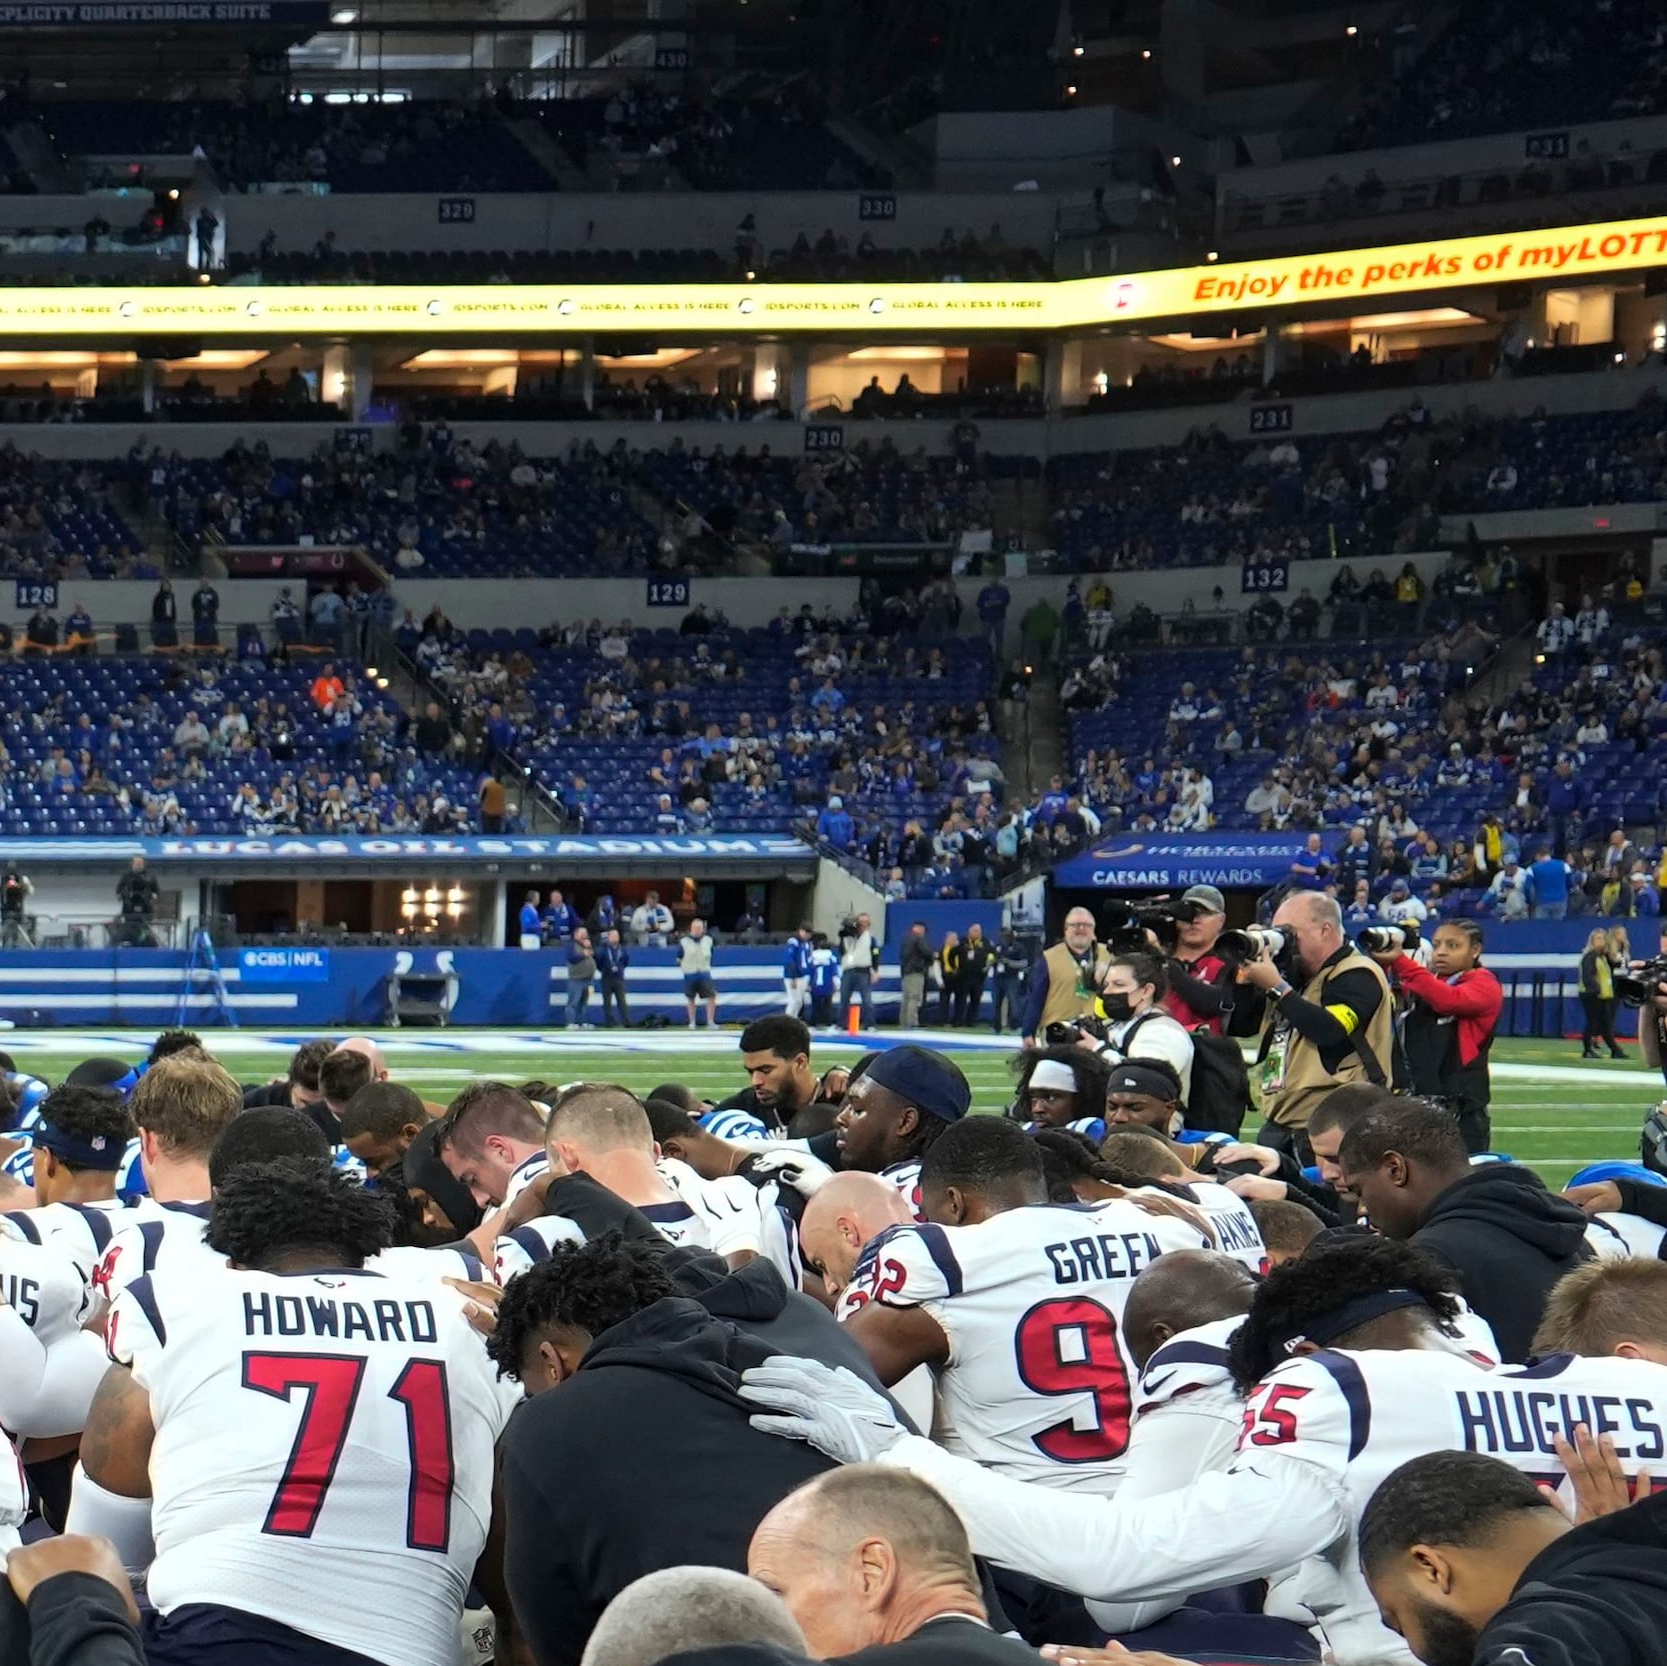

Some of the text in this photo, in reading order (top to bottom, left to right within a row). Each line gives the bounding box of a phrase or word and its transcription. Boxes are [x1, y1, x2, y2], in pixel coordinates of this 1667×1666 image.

[79, 5, 208, 21] QUARTERBACK
[211, 5, 272, 20] SUITE
[1194, 273, 1290, 302] Enjoy
[1298, 263, 1355, 290] the
[1361, 252, 1464, 288] perks
[1473, 243, 1514, 272] of
[807, 430, 843, 448] 230
[1247, 568, 1285, 588] 132
[19, 586, 55, 604] 128
[650, 584, 686, 602] 129
[161, 839, 759, 855] LUCAS OIL STADIUM
[1092, 868, 1263, 885] CAESARS REWARDS
[258, 951, 324, 967] CBS NFL
[1043, 1232, 1163, 1285] GREEN
[243, 1291, 439, 1344] HOWARD
[1455, 1389, 1666, 1460] HUGHES
[241, 1349, 455, 1555] 71
